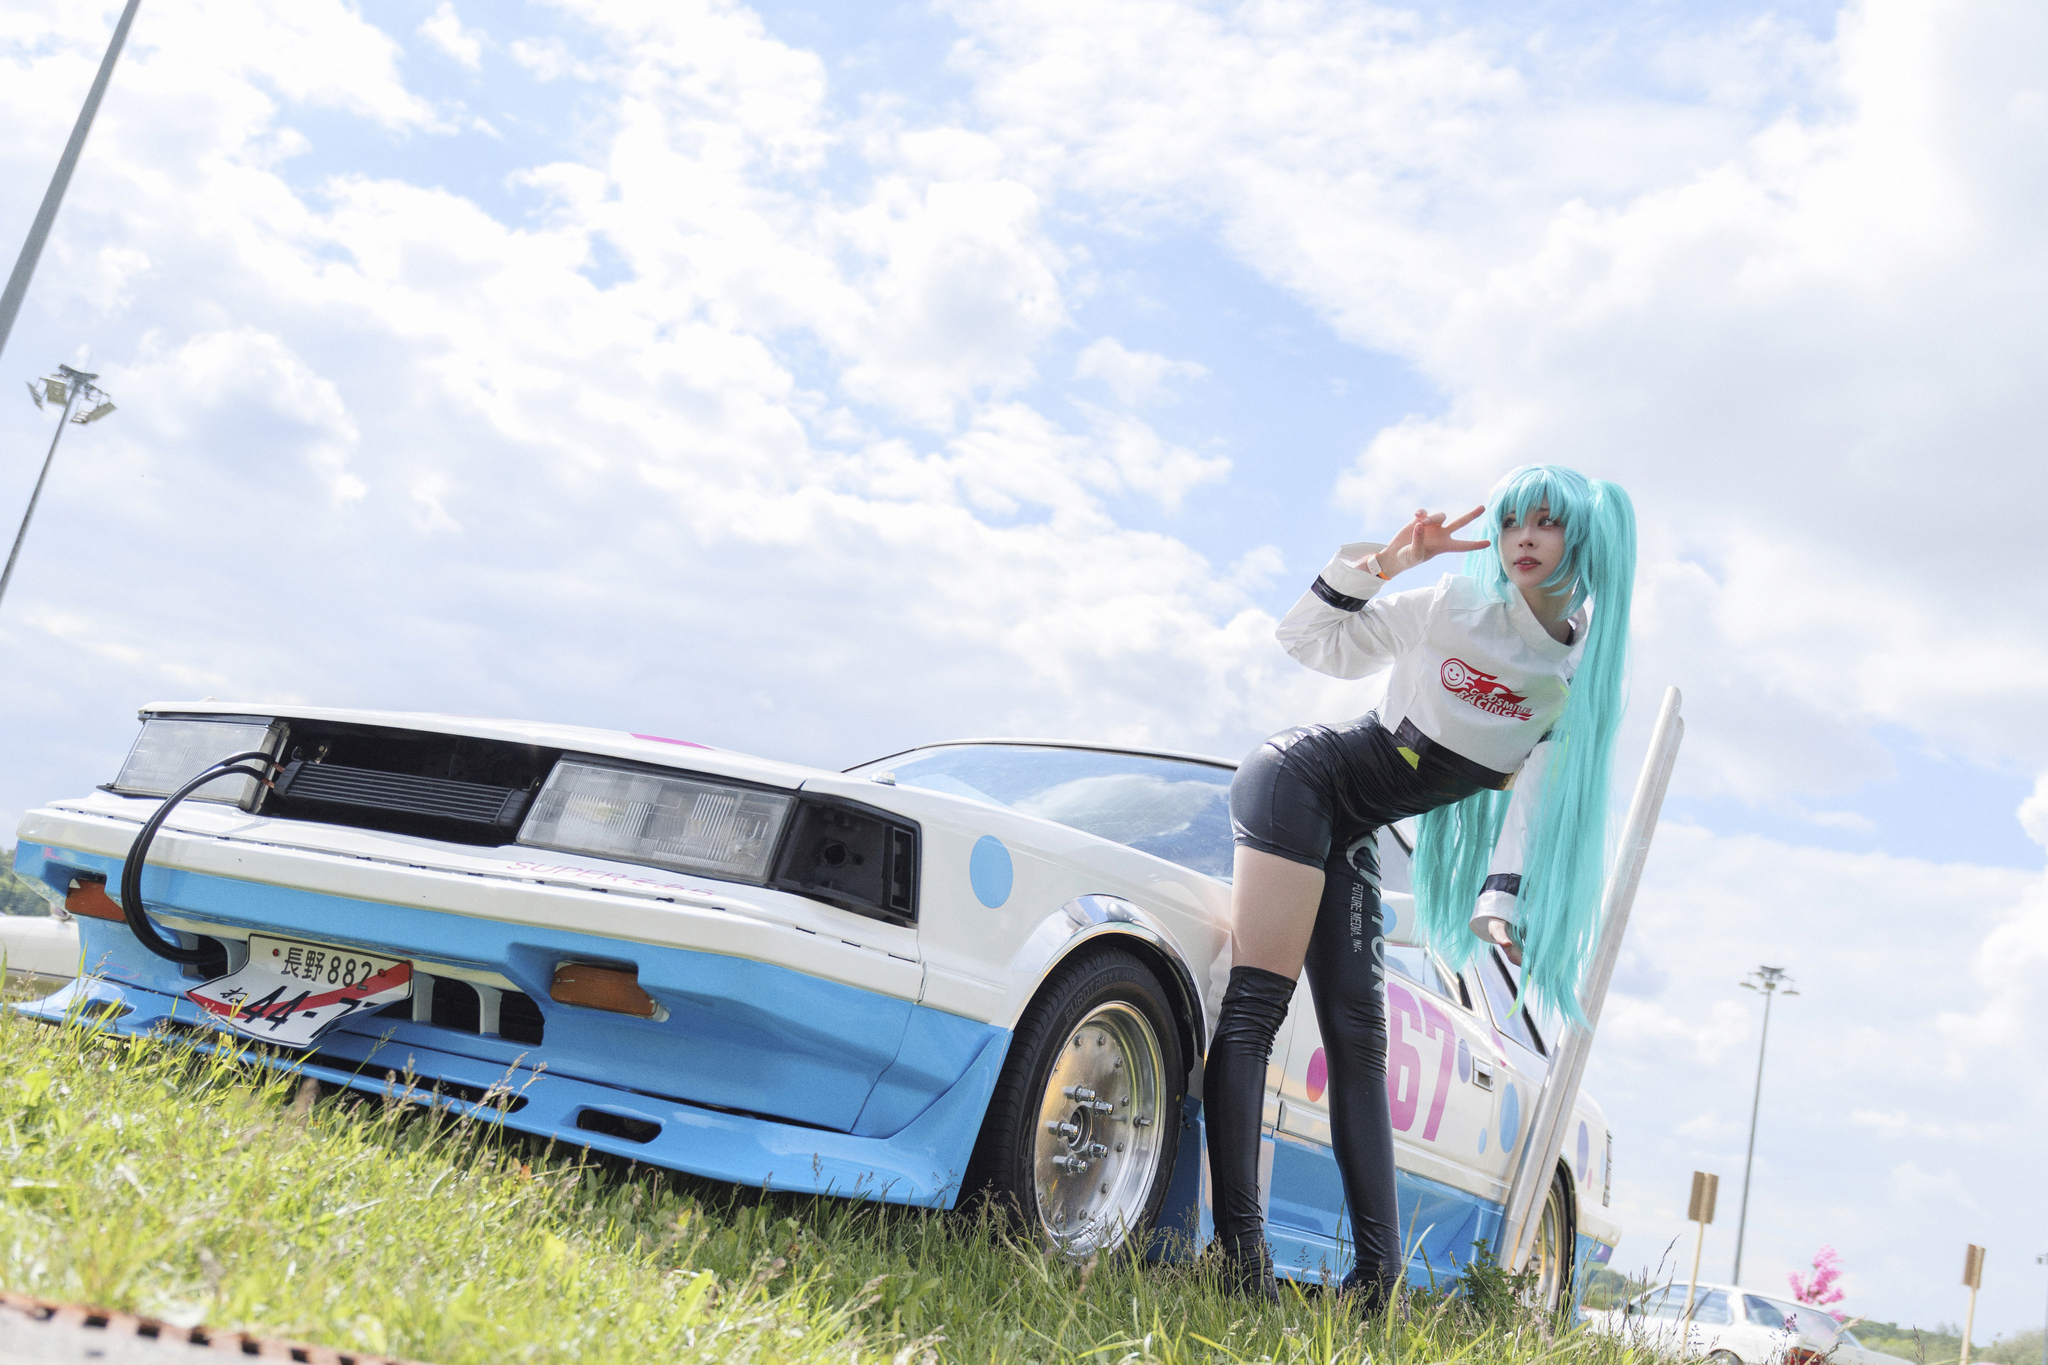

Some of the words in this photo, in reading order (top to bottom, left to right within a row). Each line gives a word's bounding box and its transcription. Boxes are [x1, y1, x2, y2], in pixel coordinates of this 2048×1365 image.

[1455, 689, 1513, 718] RACING
[506, 861, 628, 882] SUPER
[1350, 882, 1364, 912] FUTURE
[1386, 981, 1456, 1143] 67
